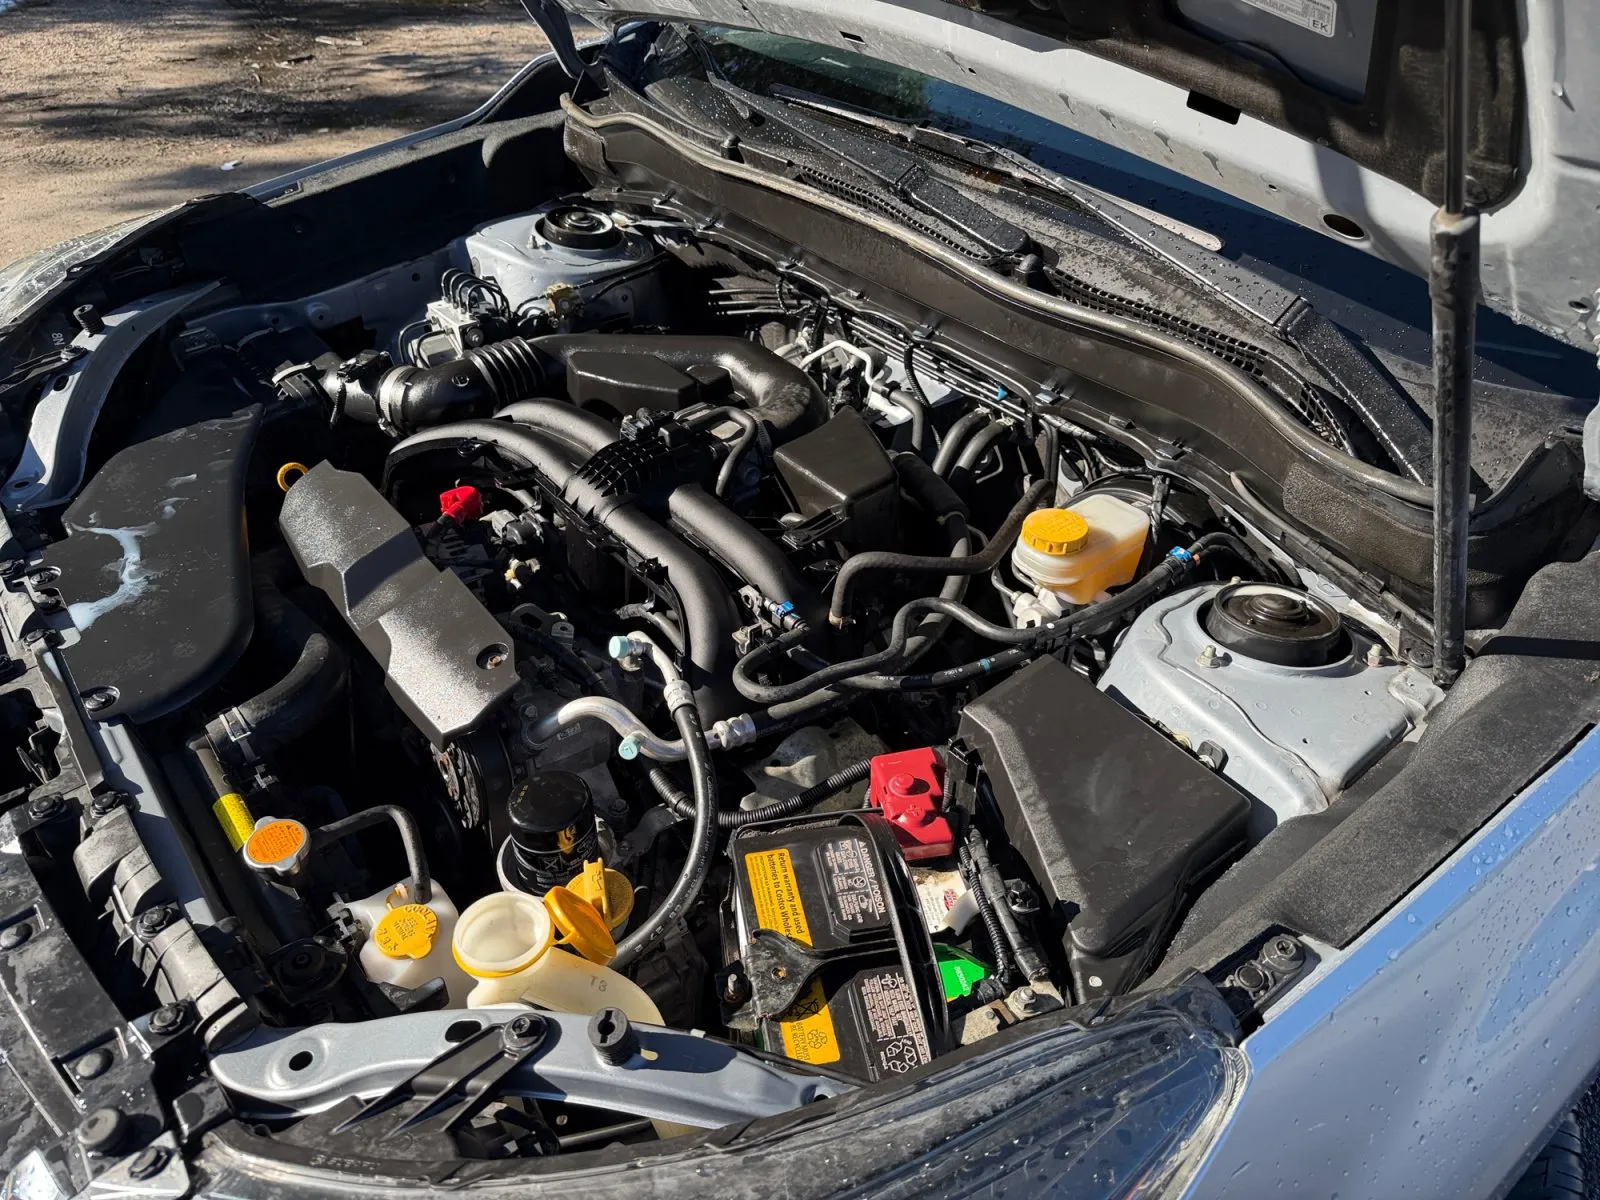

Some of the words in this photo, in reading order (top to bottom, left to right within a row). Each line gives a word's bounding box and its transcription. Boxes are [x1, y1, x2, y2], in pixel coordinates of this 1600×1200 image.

[1312, 19, 1328, 33] EK
[777, 852, 787, 872] Return
[783, 873, 794, 902] warranty
[860, 848, 875, 877] DANGER
[871, 884, 885, 913] POISON
[766, 853, 778, 880] batteries
[775, 889, 785, 910] Costco
[780, 910, 793, 939] Wholes
[789, 903, 800, 916] and
[793, 917, 804, 934] used
